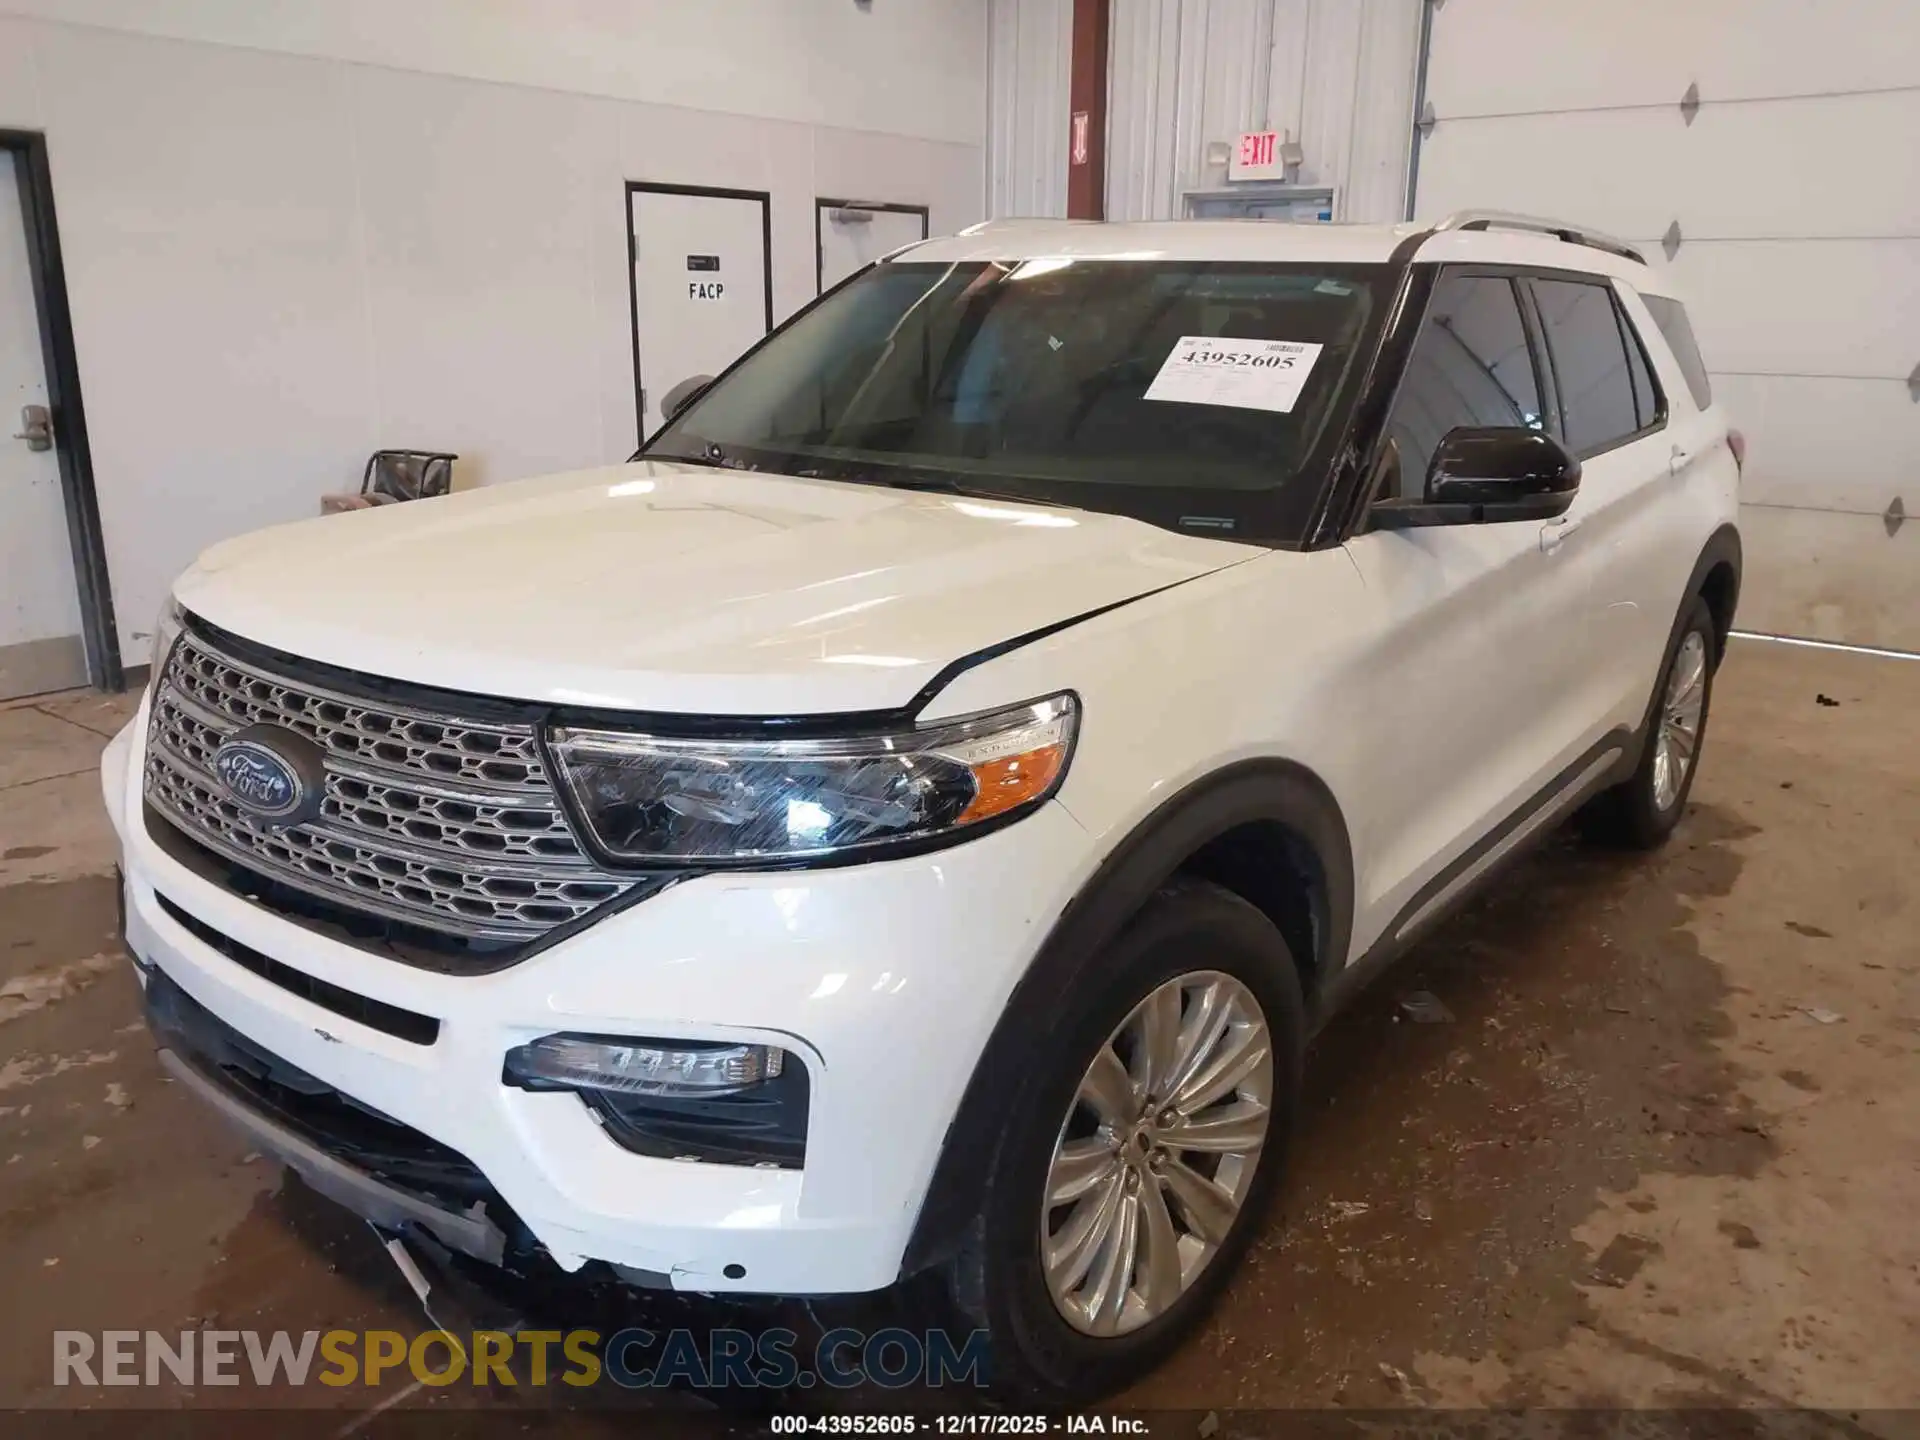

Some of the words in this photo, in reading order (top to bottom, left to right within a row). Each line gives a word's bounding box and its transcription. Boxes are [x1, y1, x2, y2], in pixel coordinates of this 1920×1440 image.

[1241, 134, 1276, 165] EXIT
[689, 283, 724, 299] FACP
[1182, 351, 1297, 370] 43952605
[226, 754, 275, 801] Ford
